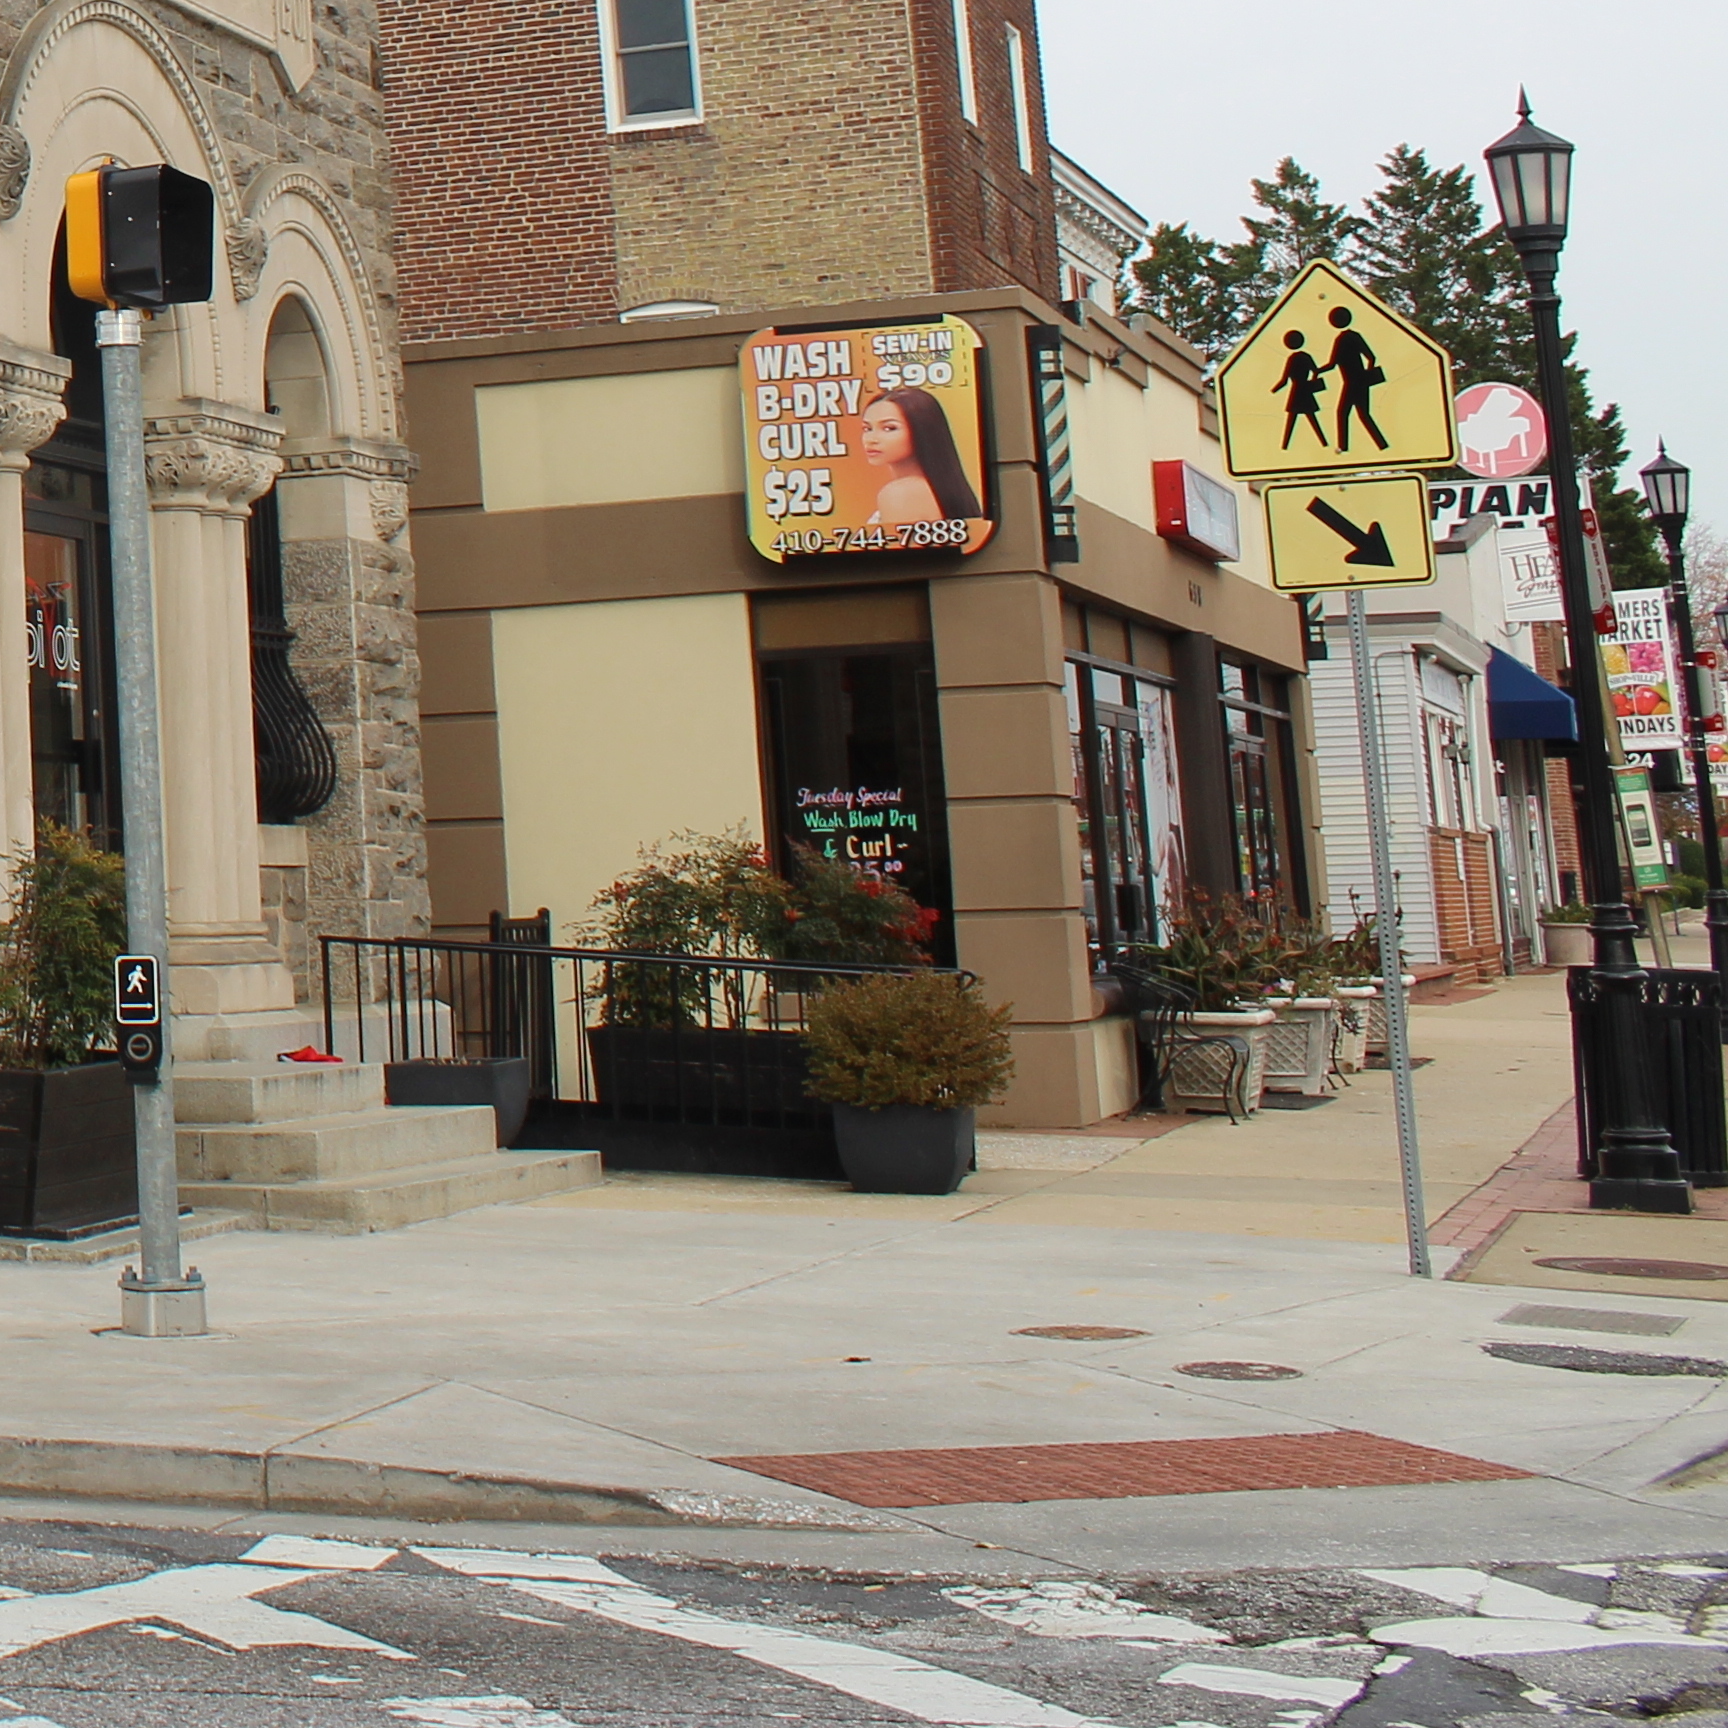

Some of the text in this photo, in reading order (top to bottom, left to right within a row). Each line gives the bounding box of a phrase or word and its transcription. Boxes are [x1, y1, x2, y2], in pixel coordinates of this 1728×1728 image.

[872, 330, 953, 355] SEW-IN
[752, 340, 852, 381] WASH
[877, 361, 953, 391] $90
[756, 379, 863, 421] B-DRY
[758, 421, 847, 461] CURL
[763, 465, 833, 522] $25
[1429, 482, 1550, 520] PIAN
[770, 518, 968, 554] 410-744-7888
[1618, 598, 1661, 619] MERS
[1602, 618, 1662, 643] RKET
[1618, 716, 1676, 735] NDAYS
[796, 786, 902, 809] Tuesday Special
[849, 810, 884, 828] Blow
[889, 809, 918, 831] Dry
[846, 833, 892, 859] Curl
